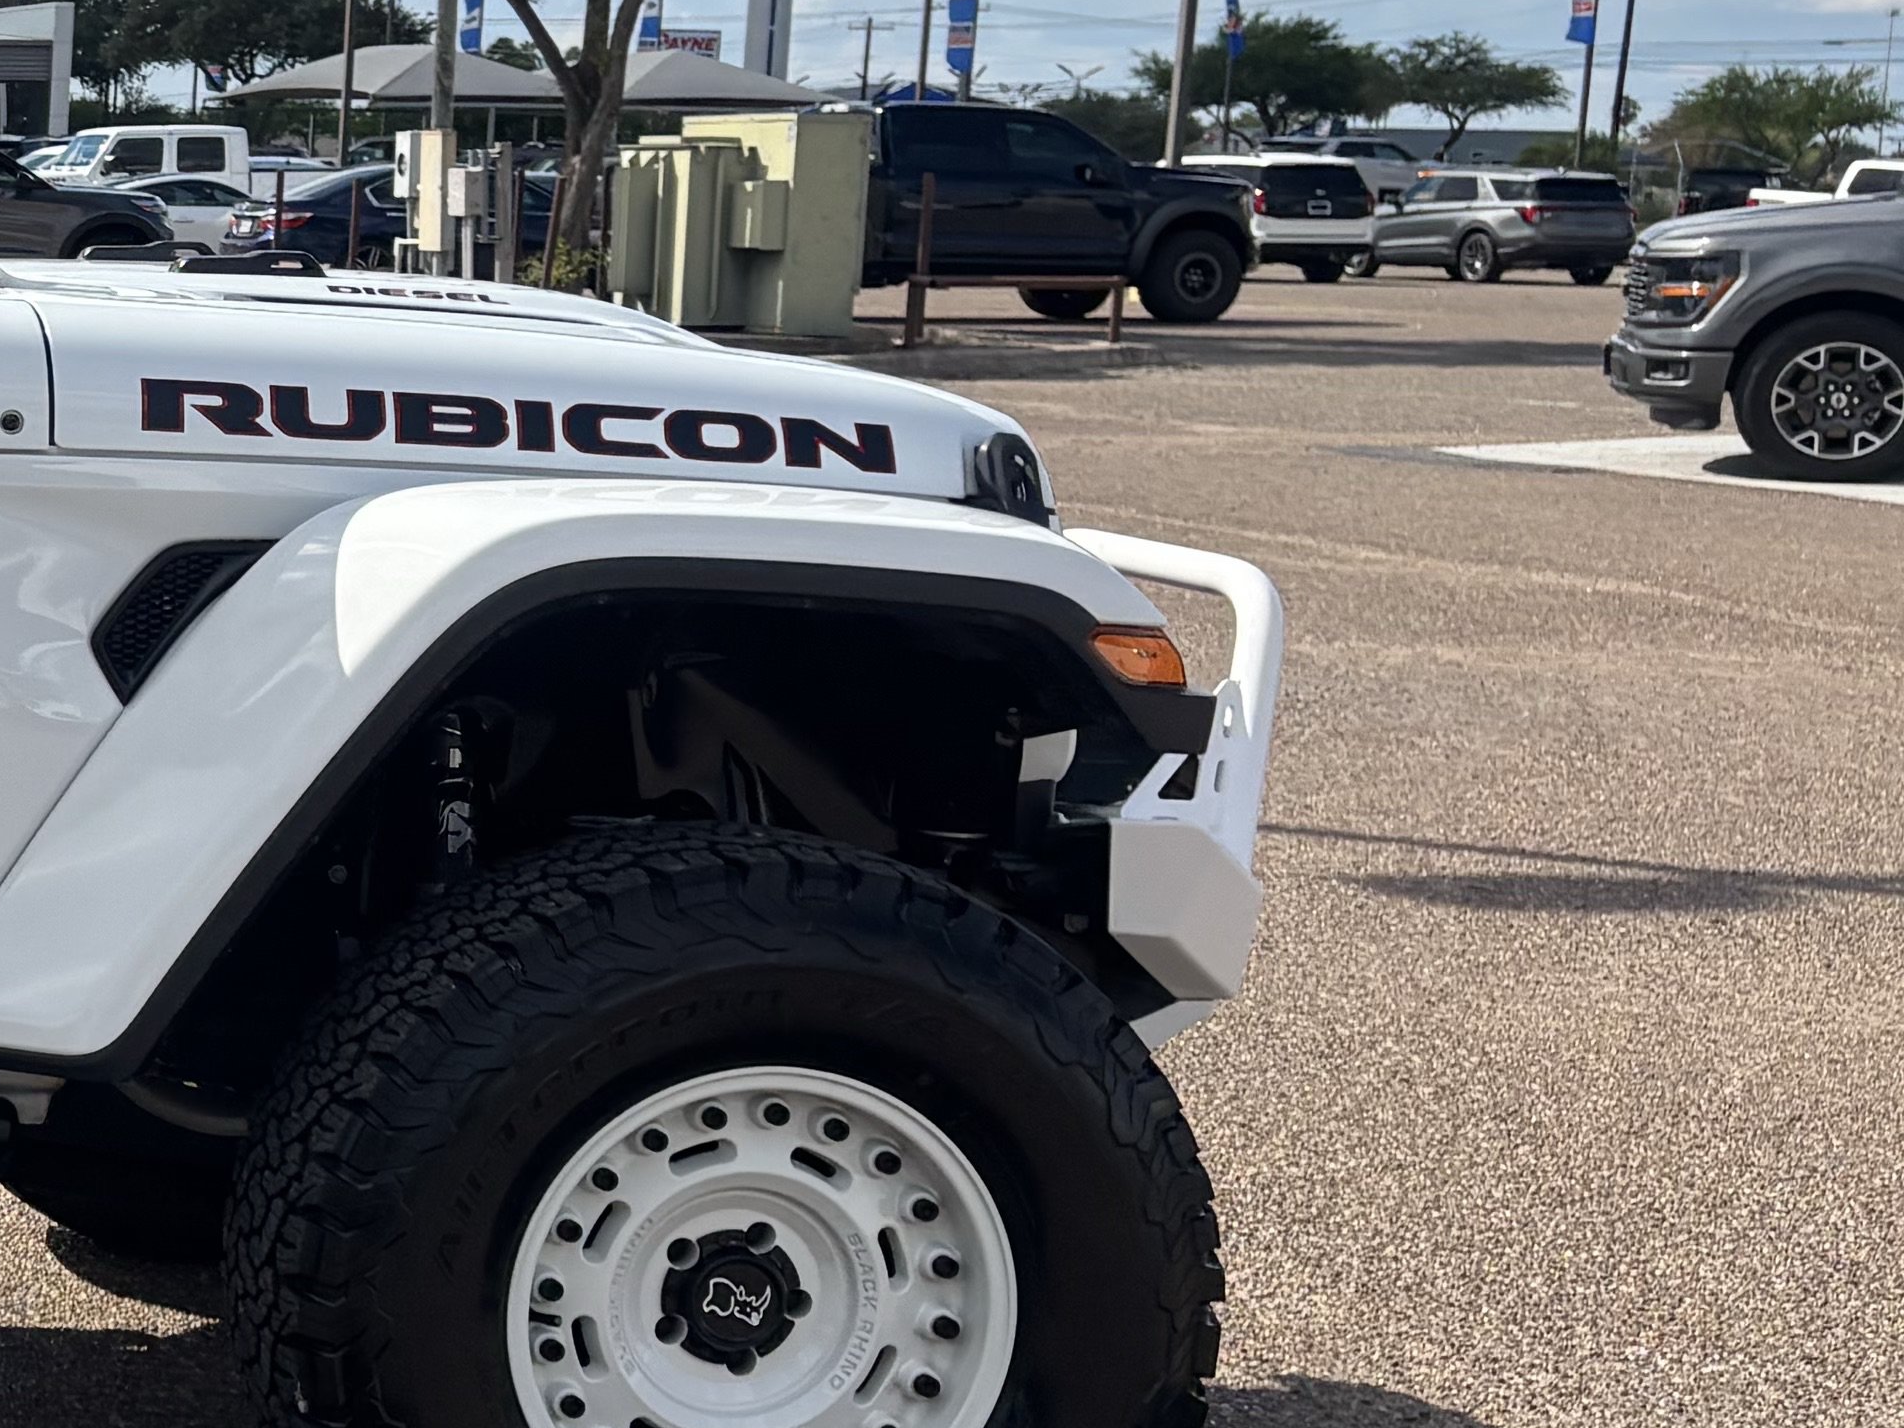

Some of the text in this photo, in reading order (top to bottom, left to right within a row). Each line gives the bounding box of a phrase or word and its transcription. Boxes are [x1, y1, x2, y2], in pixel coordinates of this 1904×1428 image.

[140, 377, 897, 475] RUBICON
[828, 1232, 879, 1390] BLACK RHINO
